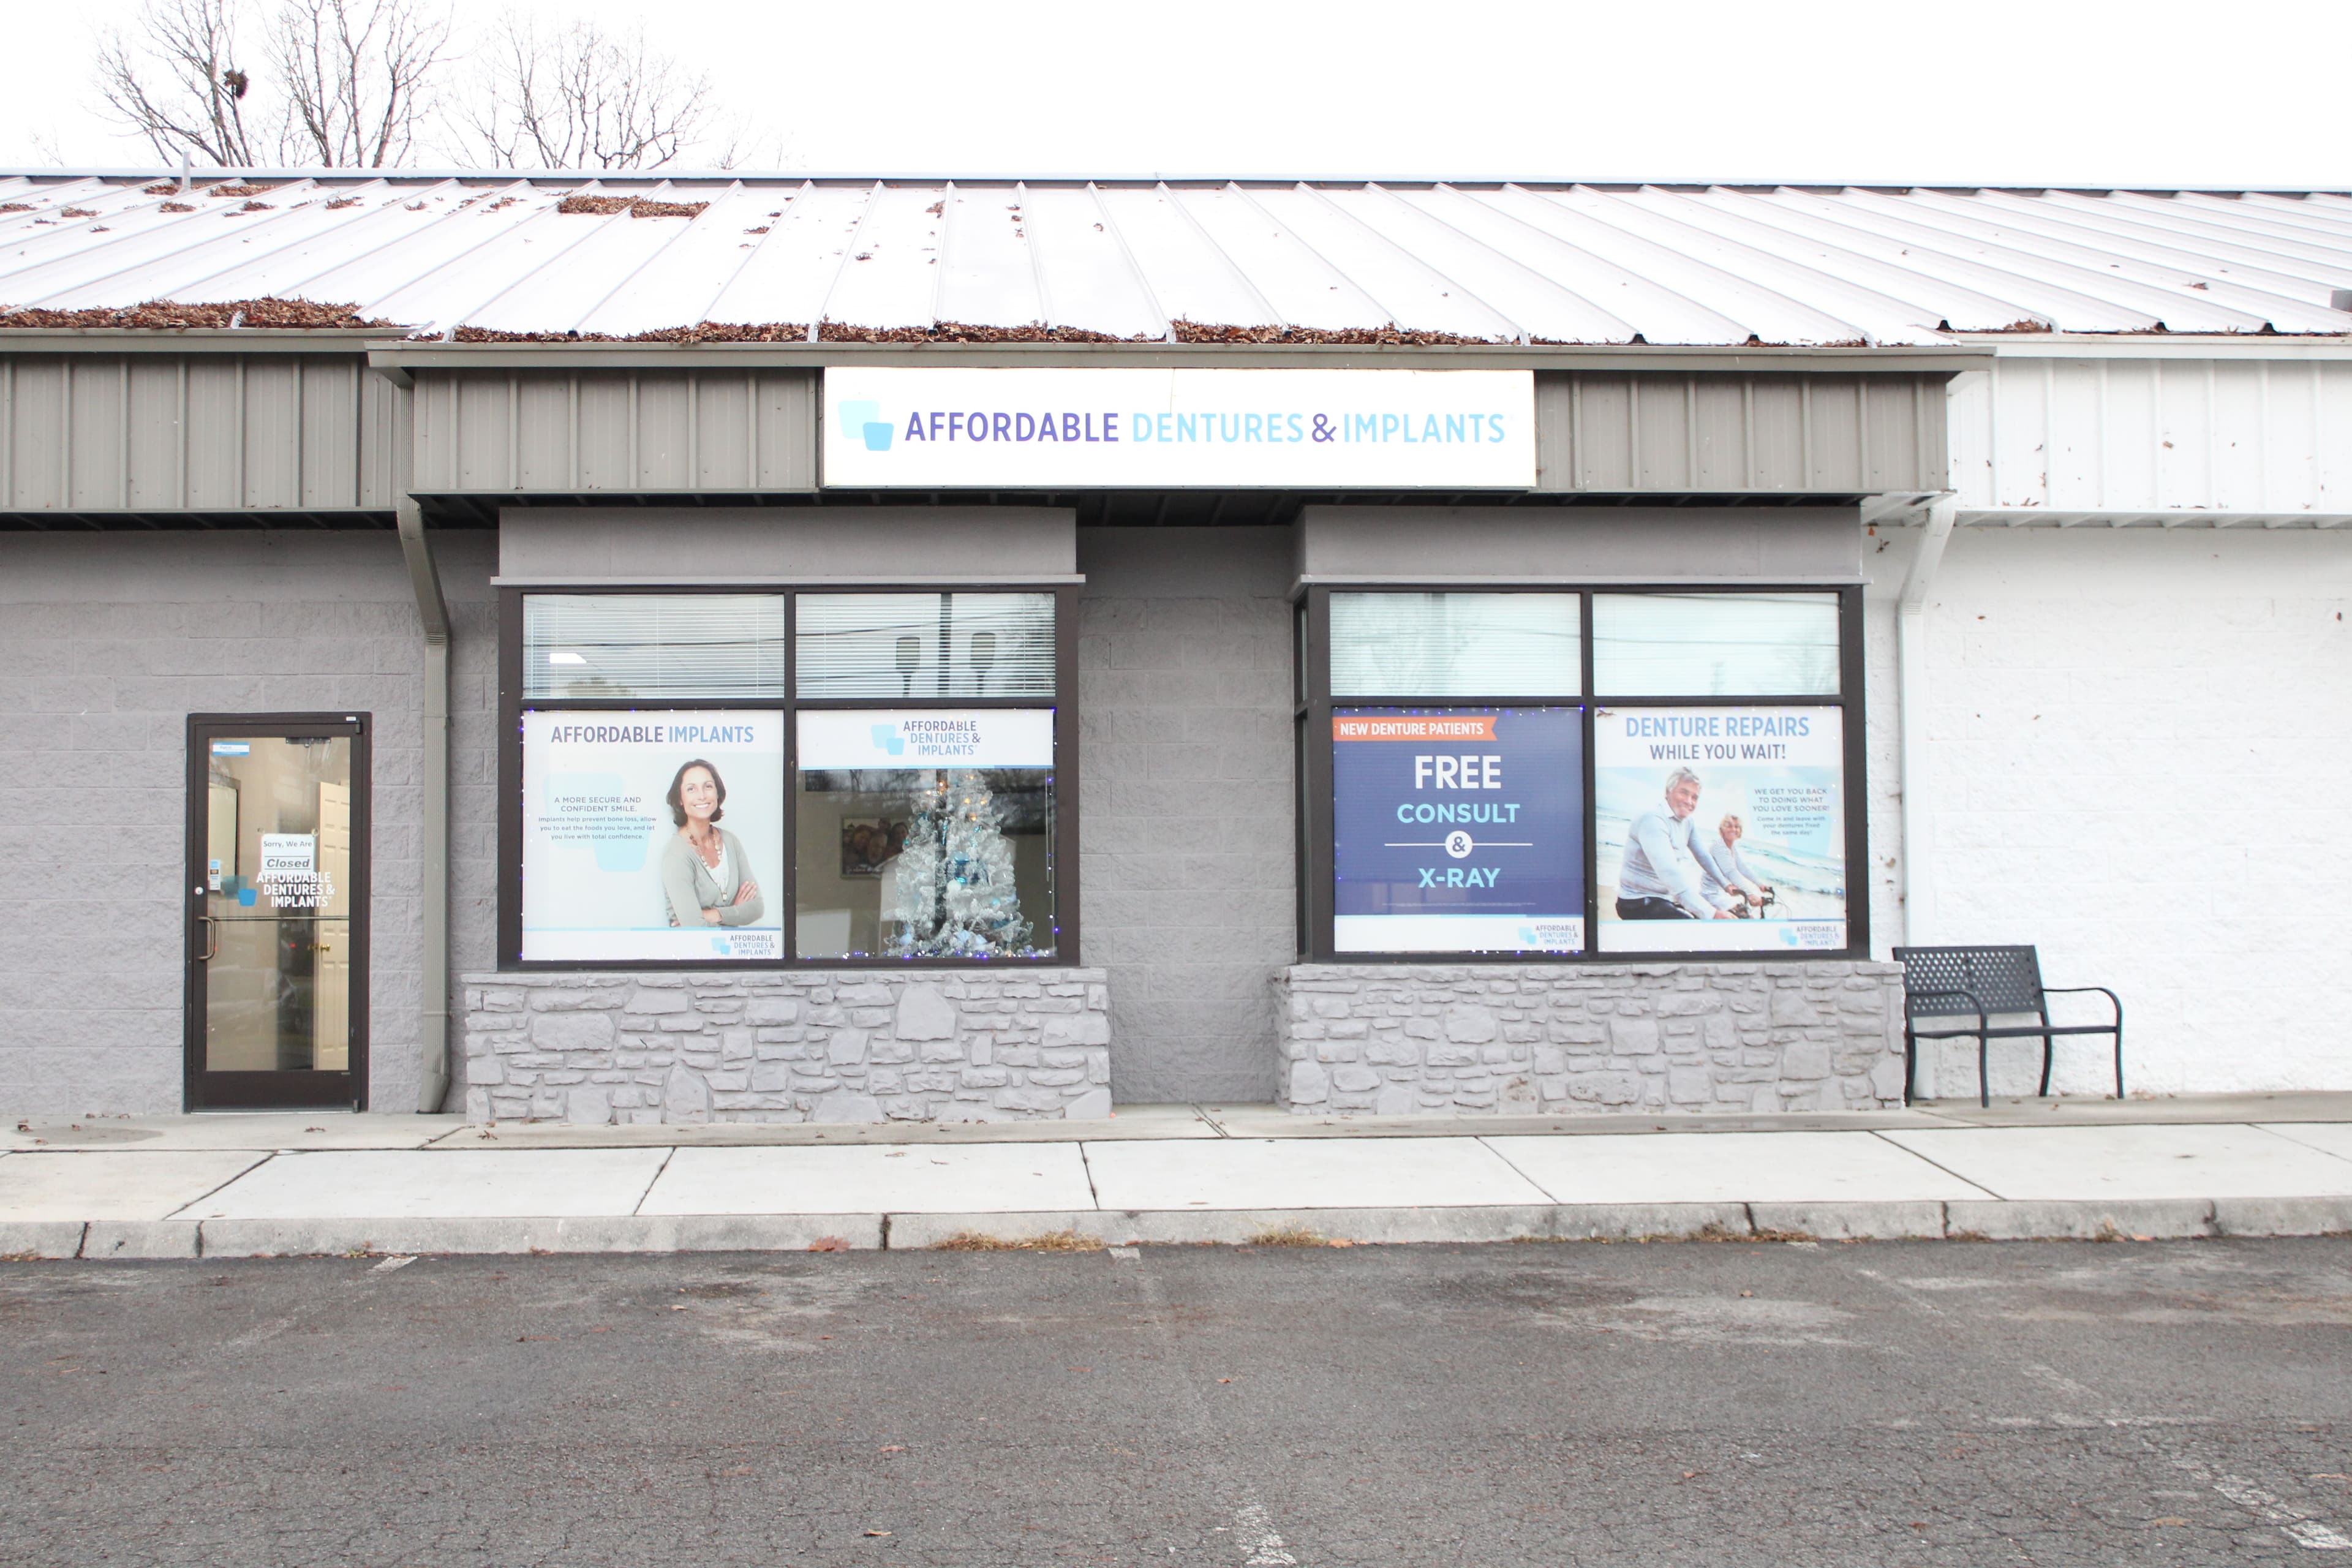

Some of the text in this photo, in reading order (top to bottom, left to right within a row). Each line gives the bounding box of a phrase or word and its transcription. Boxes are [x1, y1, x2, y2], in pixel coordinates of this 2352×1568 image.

[905, 412, 1506, 443] AFFORDABLE DENTURES & IMPLANTS
[903, 721, 976, 731] AFFORDABLE
[1340, 723, 1484, 736] NEW DENTURE PATIENTS
[1627, 717, 1809, 737] DENTURE REPAIRS
[551, 726, 754, 743] AFFORDABLE IMPLANTS
[911, 733, 981, 744] DENTURES &
[918, 745, 974, 755] IMPLANTS
[1650, 744, 1786, 760] WHILE YOU WAIT!
[1415, 755, 1501, 789] FREE
[1397, 804, 1520, 823] CONSULT
[1452, 836, 1466, 852] &
[266, 858, 310, 867] Closed
[257, 872, 331, 883] AFFORDABLE
[1418, 868, 1501, 888] X-RAY
[264, 884, 335, 895] DENTURES &
[271, 895, 328, 907] IMPLANTS
